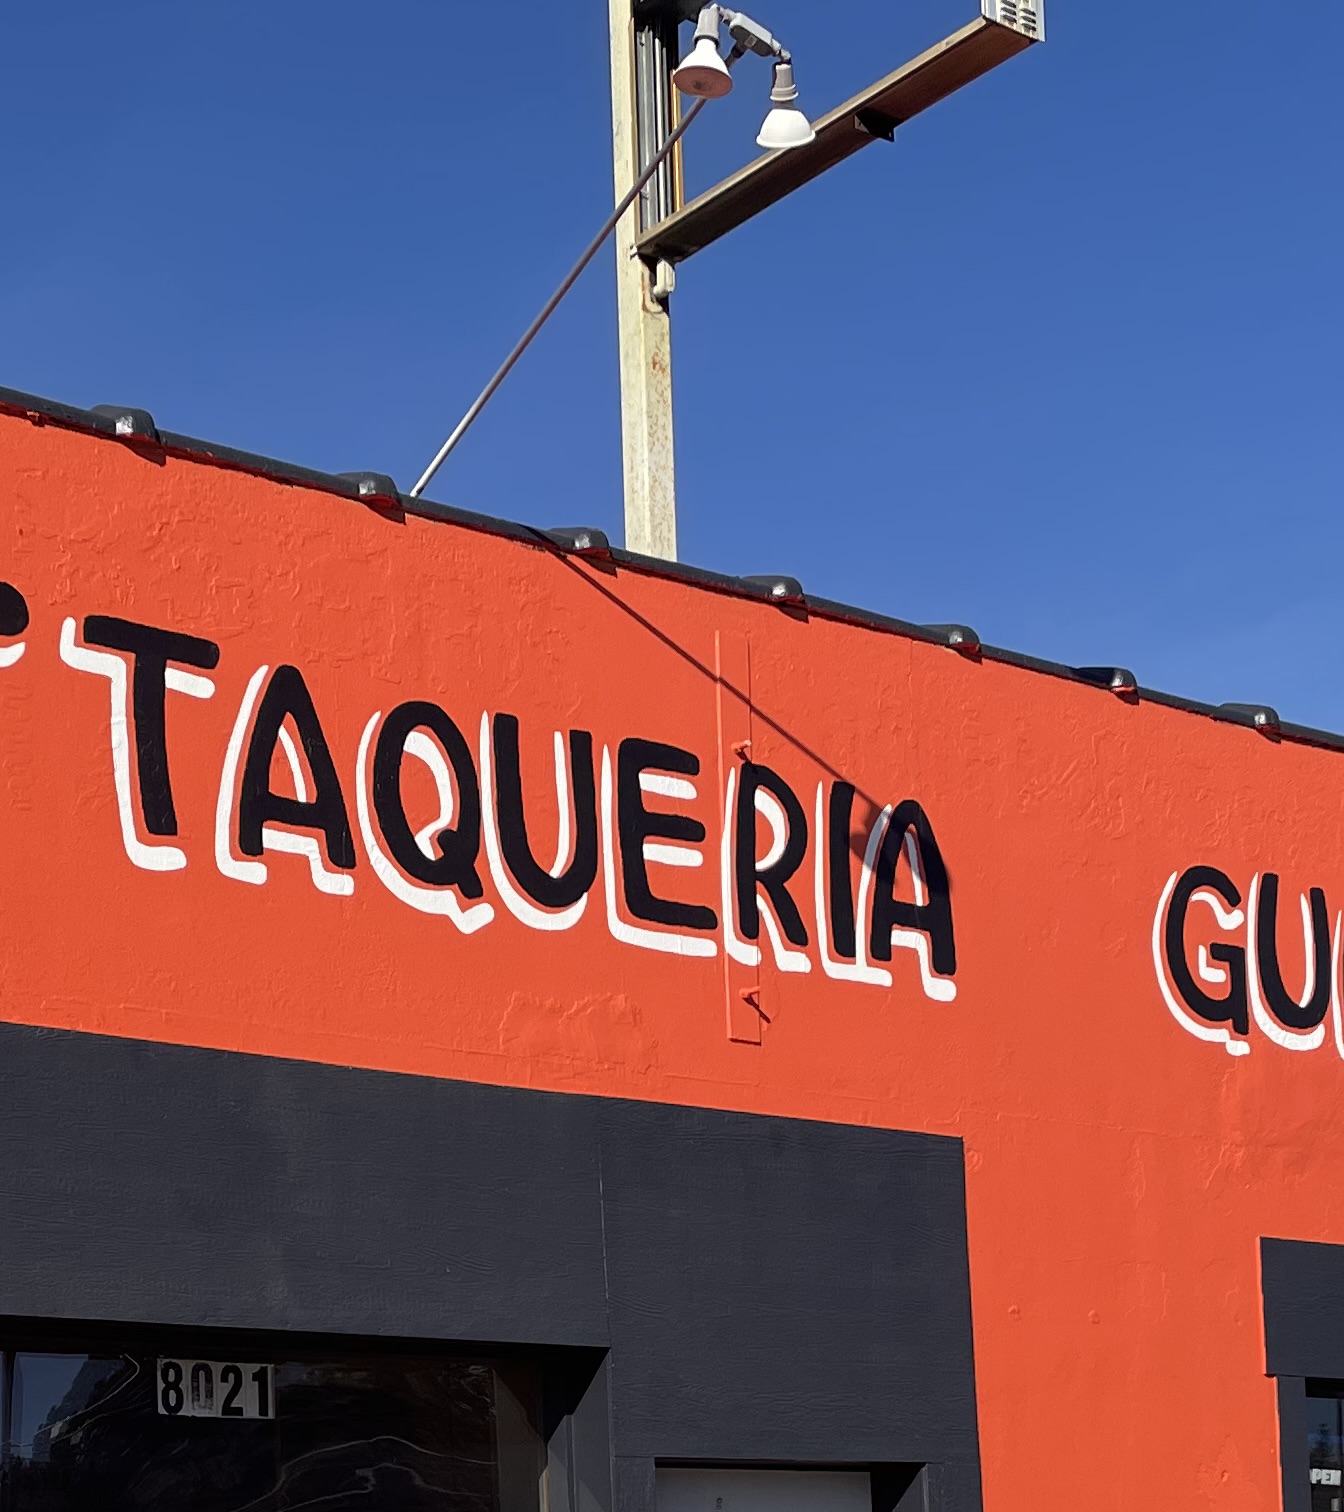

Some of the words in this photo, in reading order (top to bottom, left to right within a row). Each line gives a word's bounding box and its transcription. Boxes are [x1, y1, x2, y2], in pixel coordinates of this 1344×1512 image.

[61, 613, 957, 1002] TAQUERIA
[160, 1360, 269, 1417] 8021
[1309, 1468, 1342, 1486] PEN
